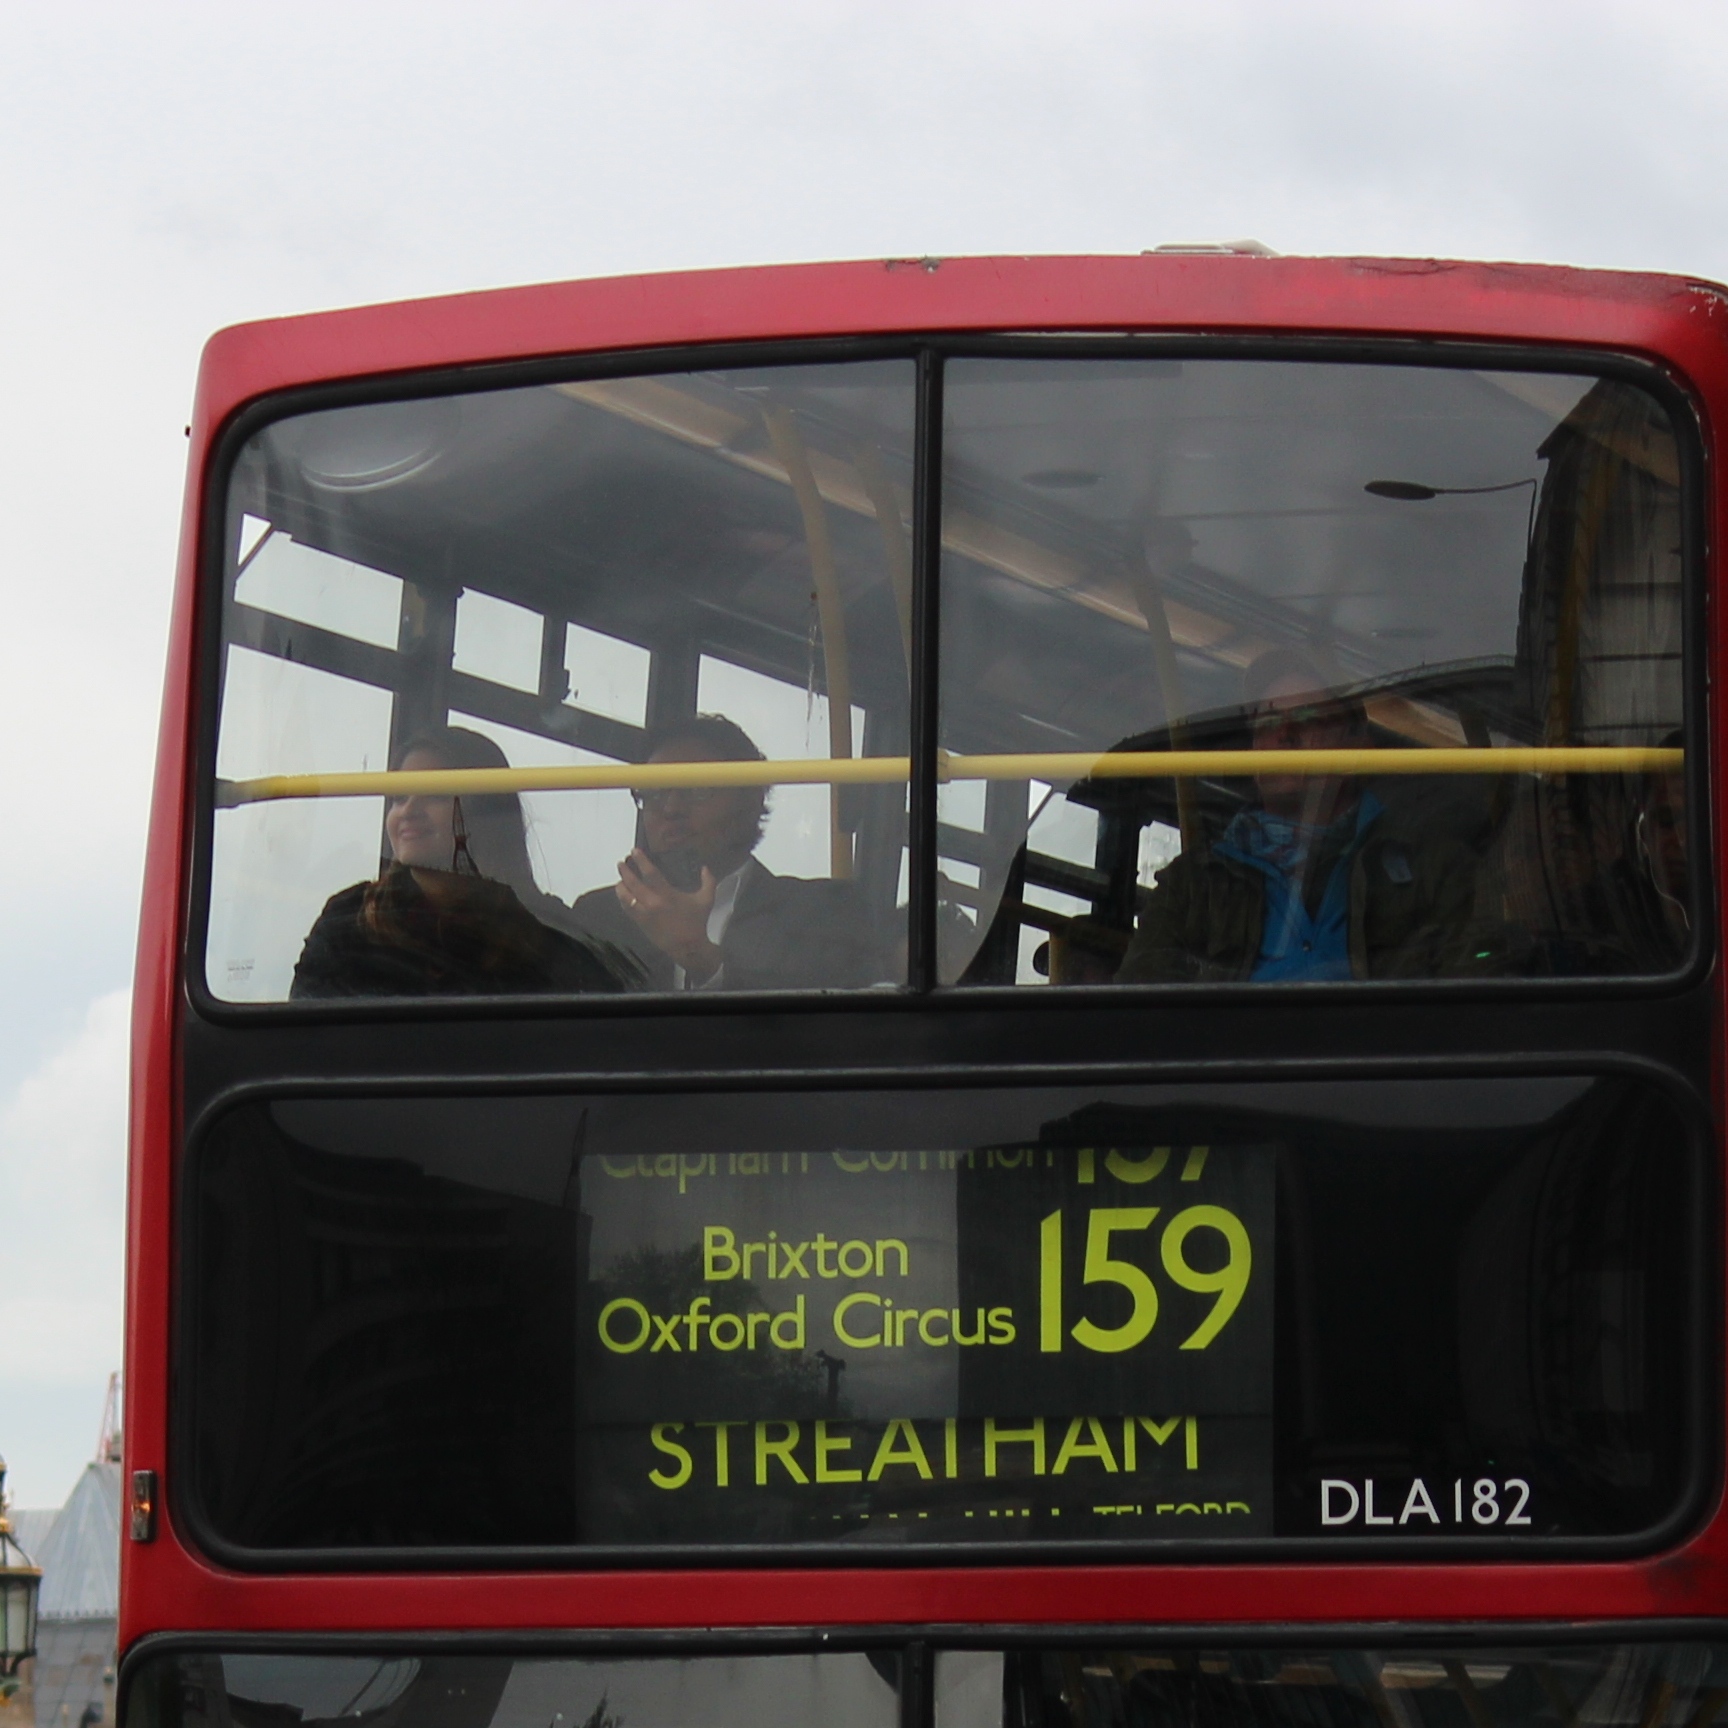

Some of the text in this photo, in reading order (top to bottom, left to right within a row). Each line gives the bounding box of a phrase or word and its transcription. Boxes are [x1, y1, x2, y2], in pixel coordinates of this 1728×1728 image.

[703, 1225, 909, 1282] Brixton
[1039, 1204, 1253, 1354] 159
[598, 1291, 1017, 1355] Oxford Circus
[648, 1416, 1200, 1491] STREATHAM
[1321, 1478, 1532, 1525] DLA 182
